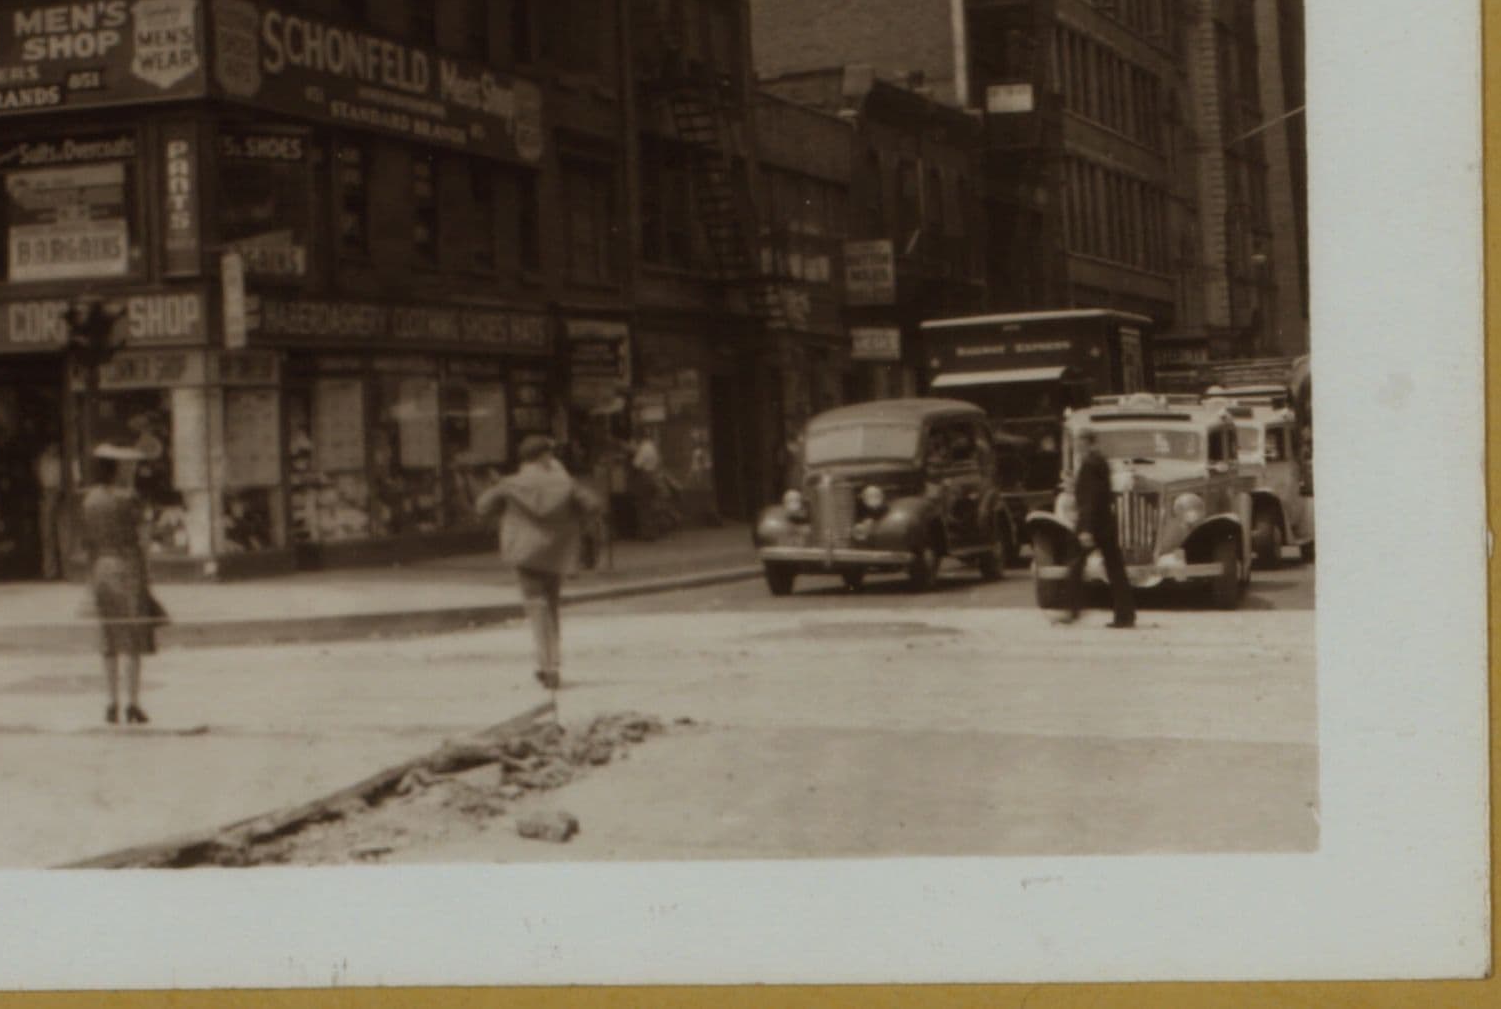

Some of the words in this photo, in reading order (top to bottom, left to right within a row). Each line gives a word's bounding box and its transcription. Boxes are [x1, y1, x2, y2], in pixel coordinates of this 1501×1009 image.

[12, 0, 130, 36] MEN'S
[21, 30, 123, 62] SHOP
[262, 8, 430, 93] SCHONFELD
[16, 235, 121, 266] BARGAINS
[127, 293, 199, 337] SHOP
